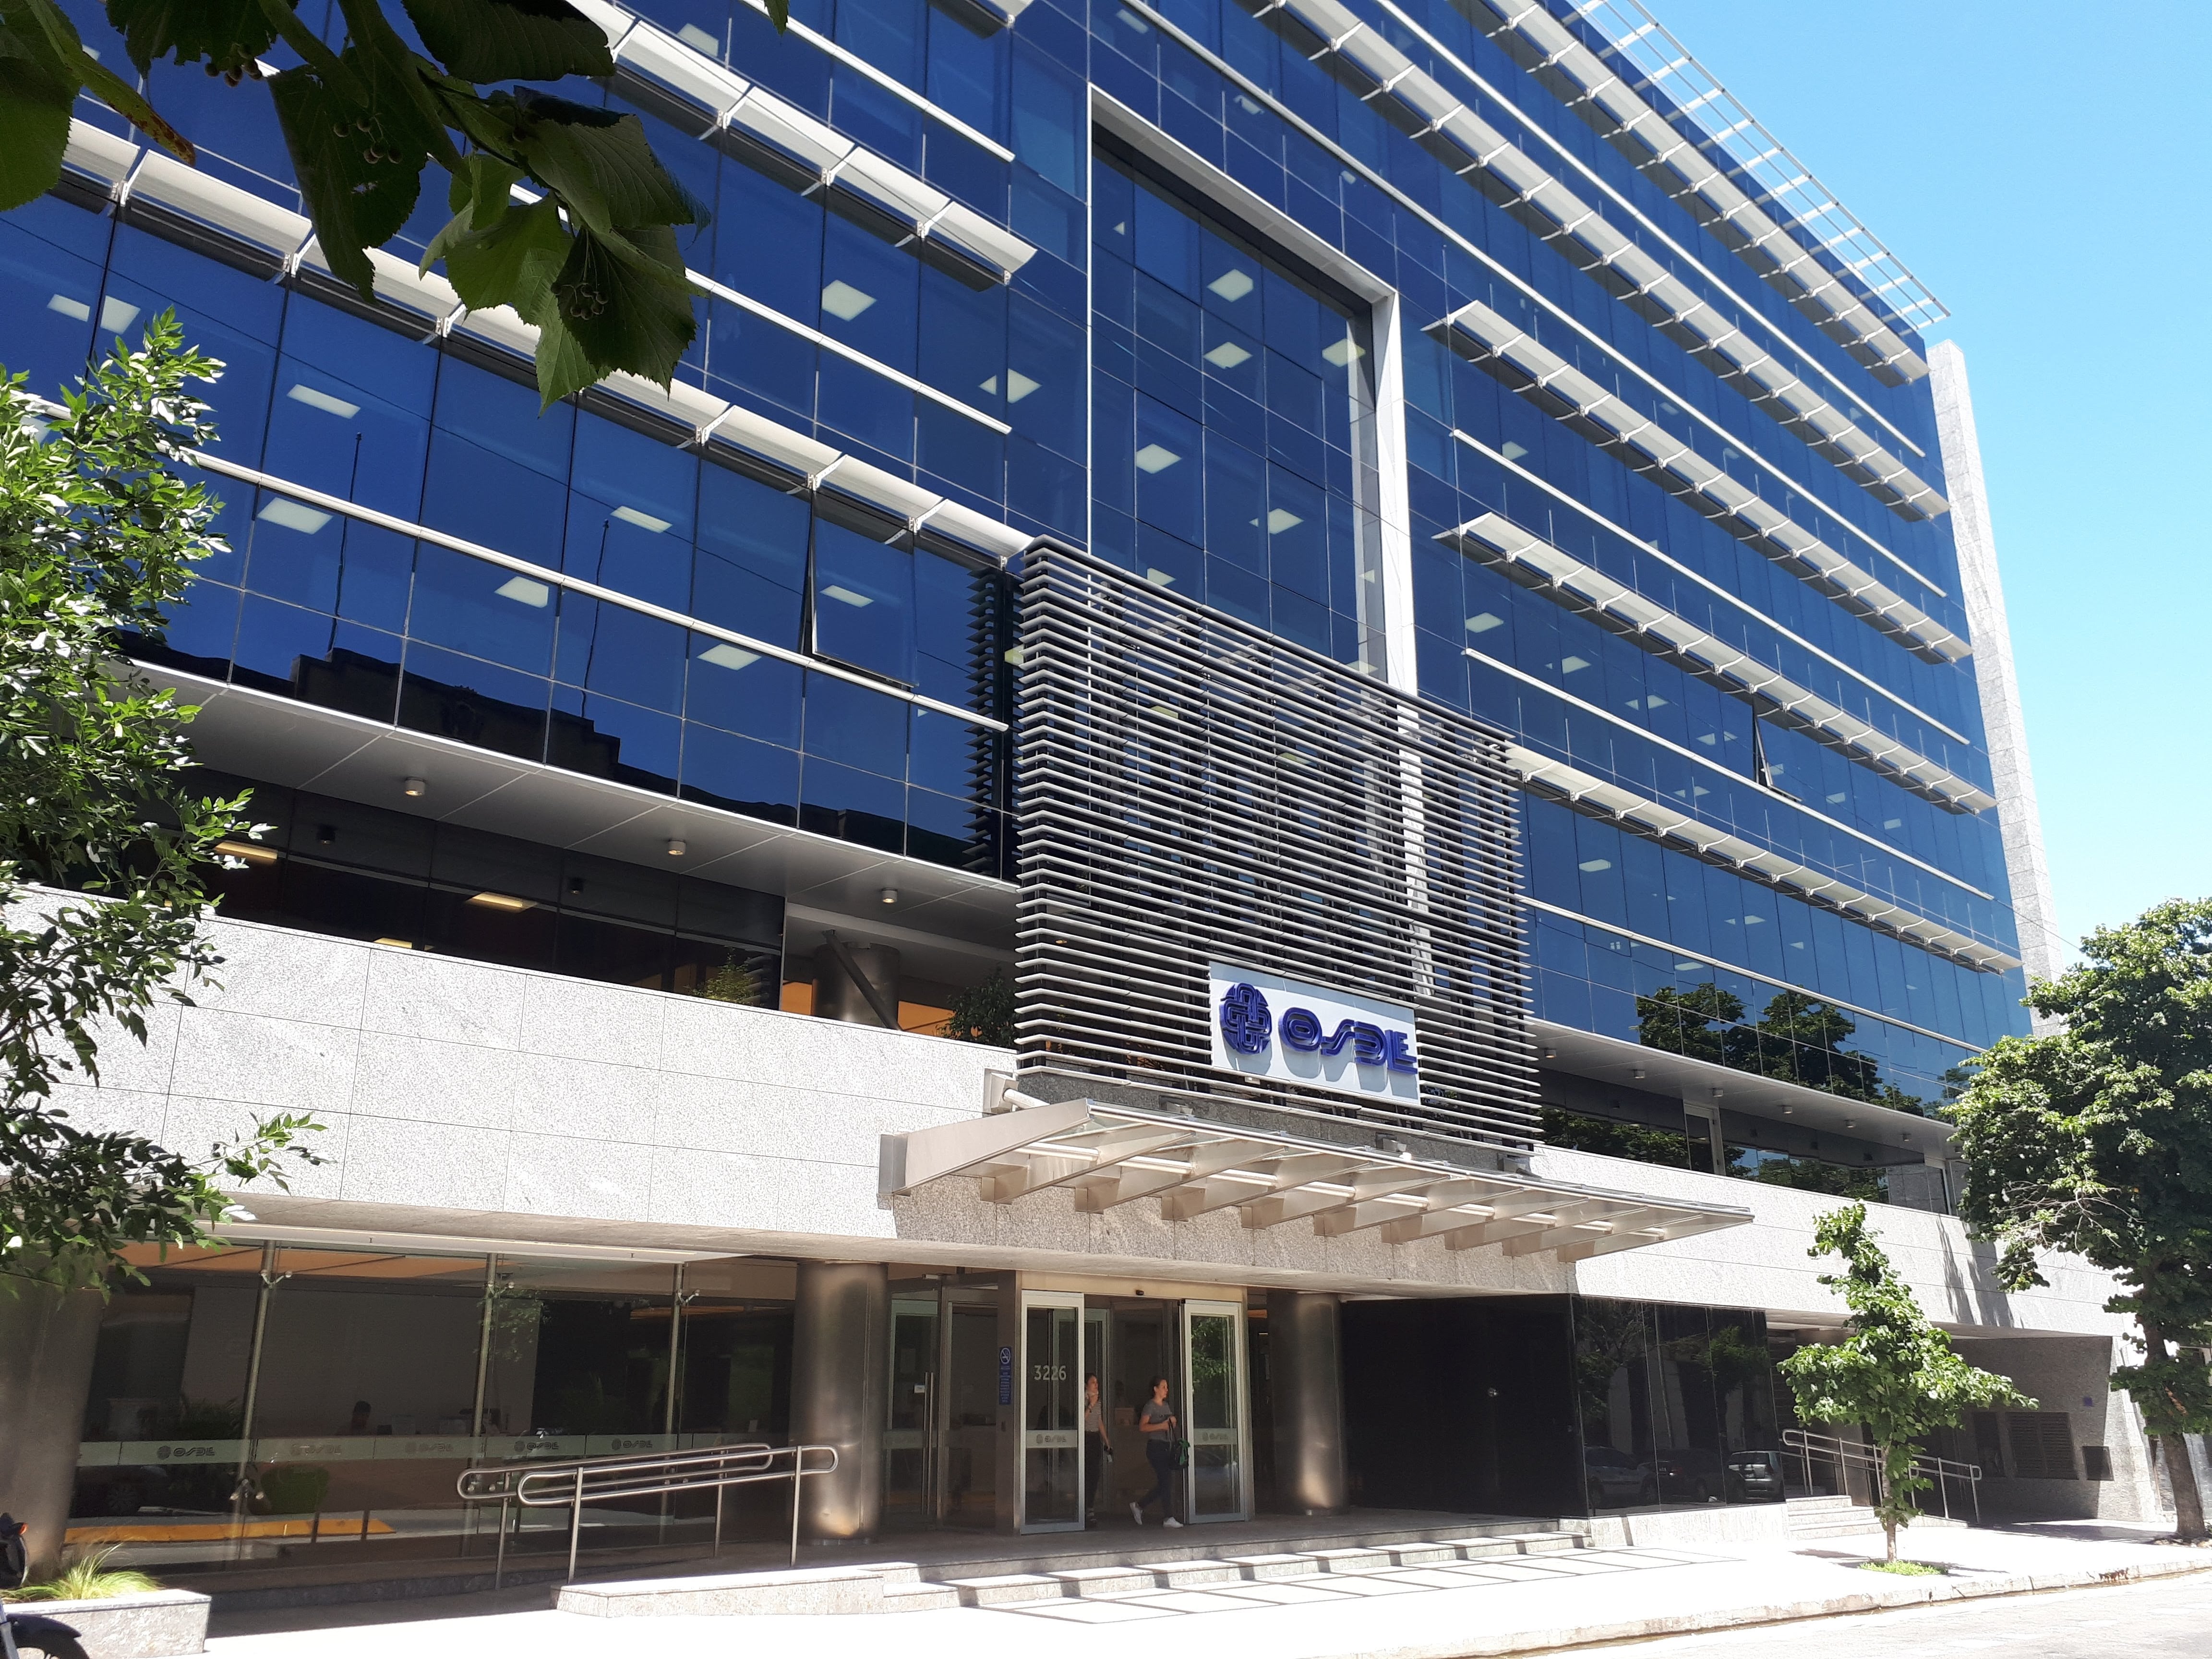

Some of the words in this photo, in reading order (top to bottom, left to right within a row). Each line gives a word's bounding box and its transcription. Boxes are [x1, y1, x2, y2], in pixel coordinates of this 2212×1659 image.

[1278, 1008, 1418, 1074] OSDE
[1034, 1365, 1067, 1380] 3226
[173, 1447, 215, 1457] OSDE
[527, 1442, 559, 1450] OSDE
